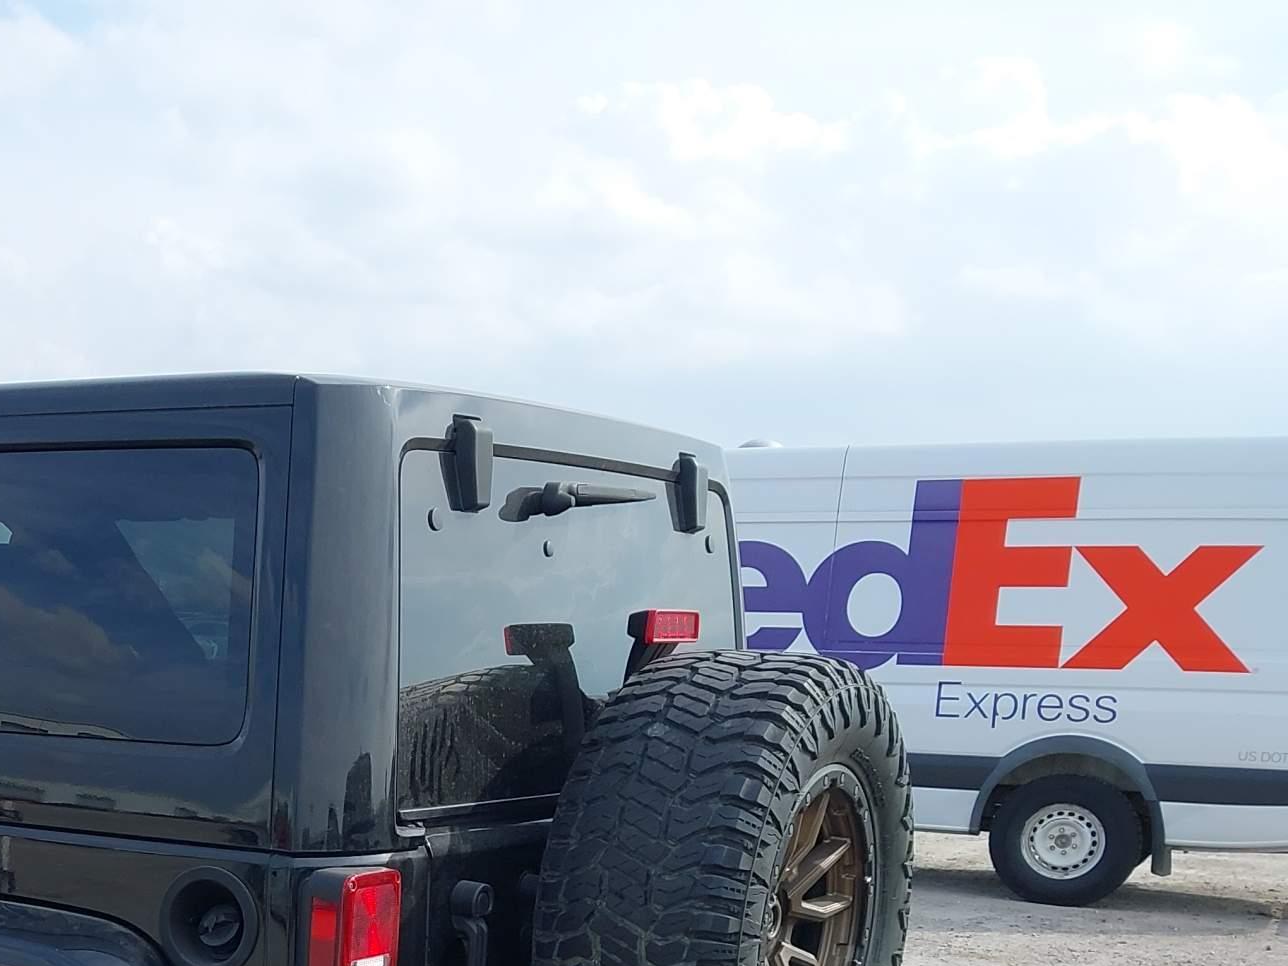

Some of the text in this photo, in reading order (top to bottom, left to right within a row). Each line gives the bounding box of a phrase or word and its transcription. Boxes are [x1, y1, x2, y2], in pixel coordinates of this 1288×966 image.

[935, 681, 1118, 728] Express
[1237, 751, 1288, 764] US DOT
